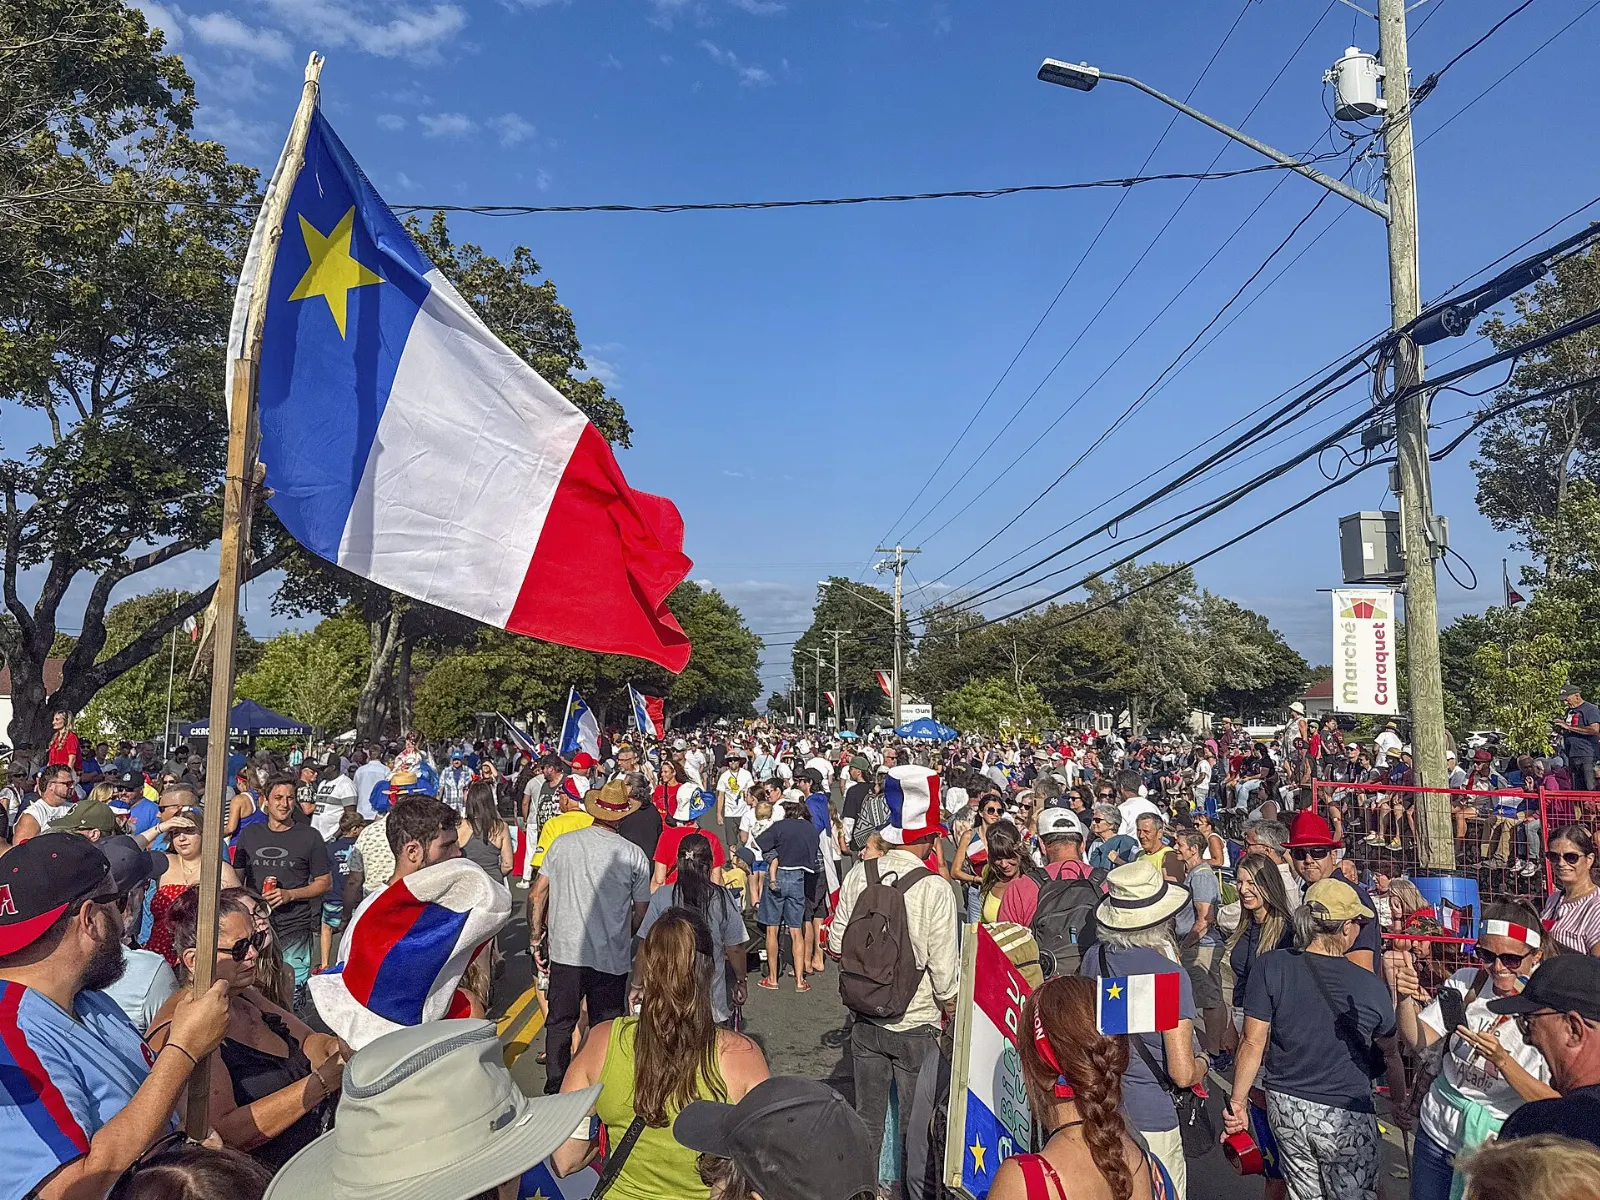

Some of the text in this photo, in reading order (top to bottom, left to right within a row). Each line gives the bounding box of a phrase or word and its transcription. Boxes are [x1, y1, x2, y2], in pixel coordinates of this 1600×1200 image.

[1341, 622, 1358, 704] marché
[1373, 622, 1389, 705] Caraquet
[1294, 740, 1303, 748] 15
[252, 859, 296, 867] AKLEY
